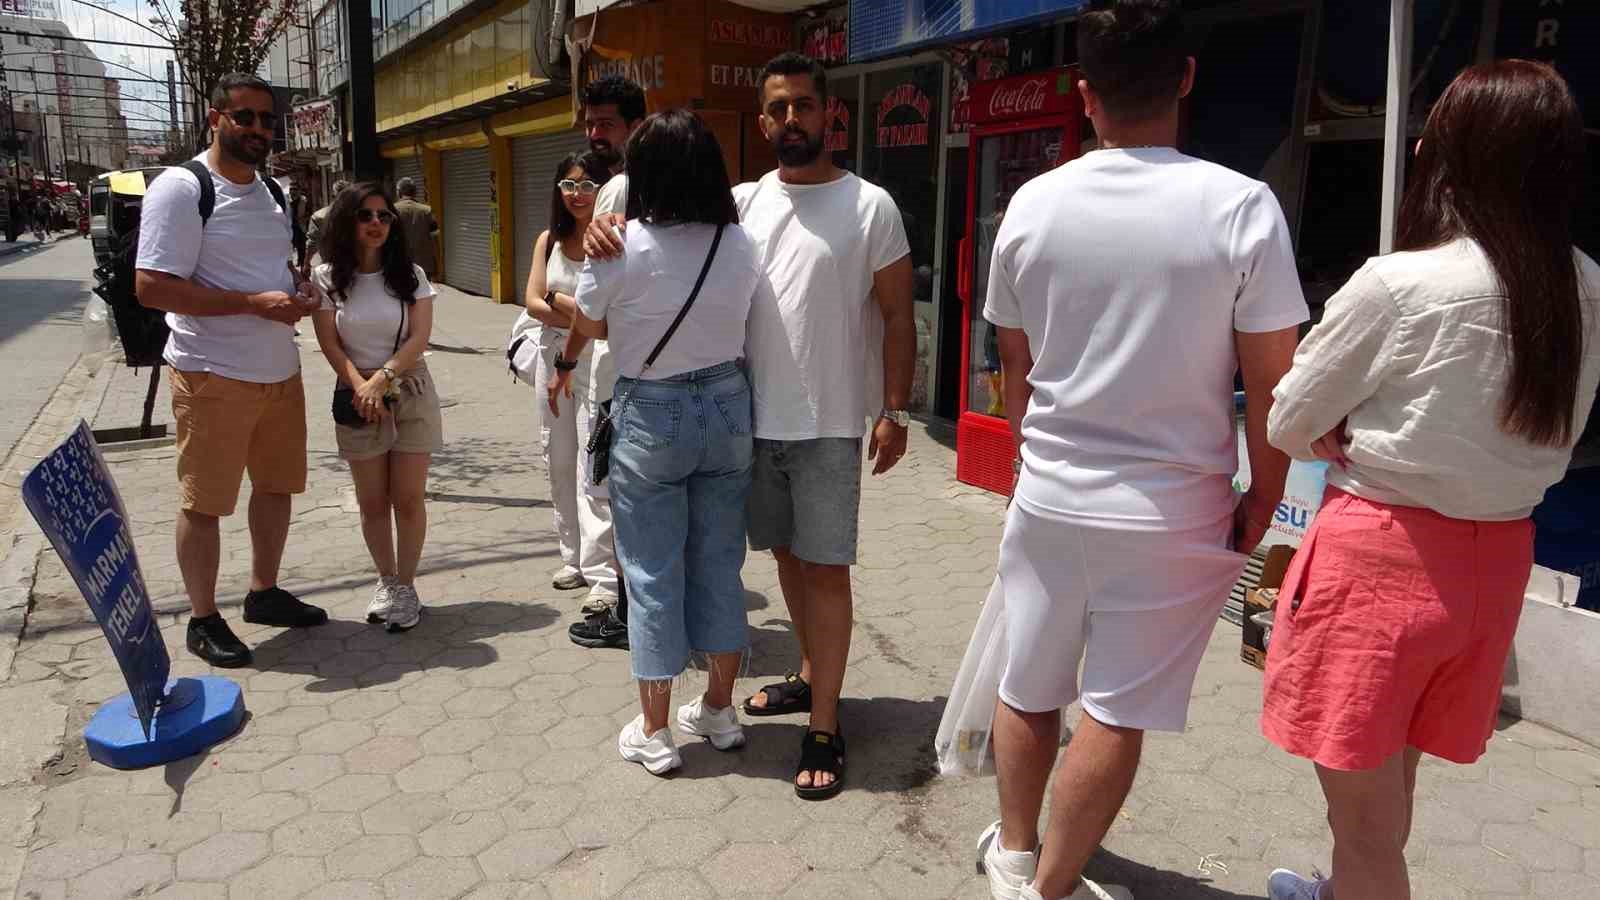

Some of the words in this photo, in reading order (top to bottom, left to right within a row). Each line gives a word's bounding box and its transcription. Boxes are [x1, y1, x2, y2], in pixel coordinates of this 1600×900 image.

[711, 64, 729, 86] ET
[1274, 503, 1307, 528] su
[108, 583, 140, 645] TEKEL
